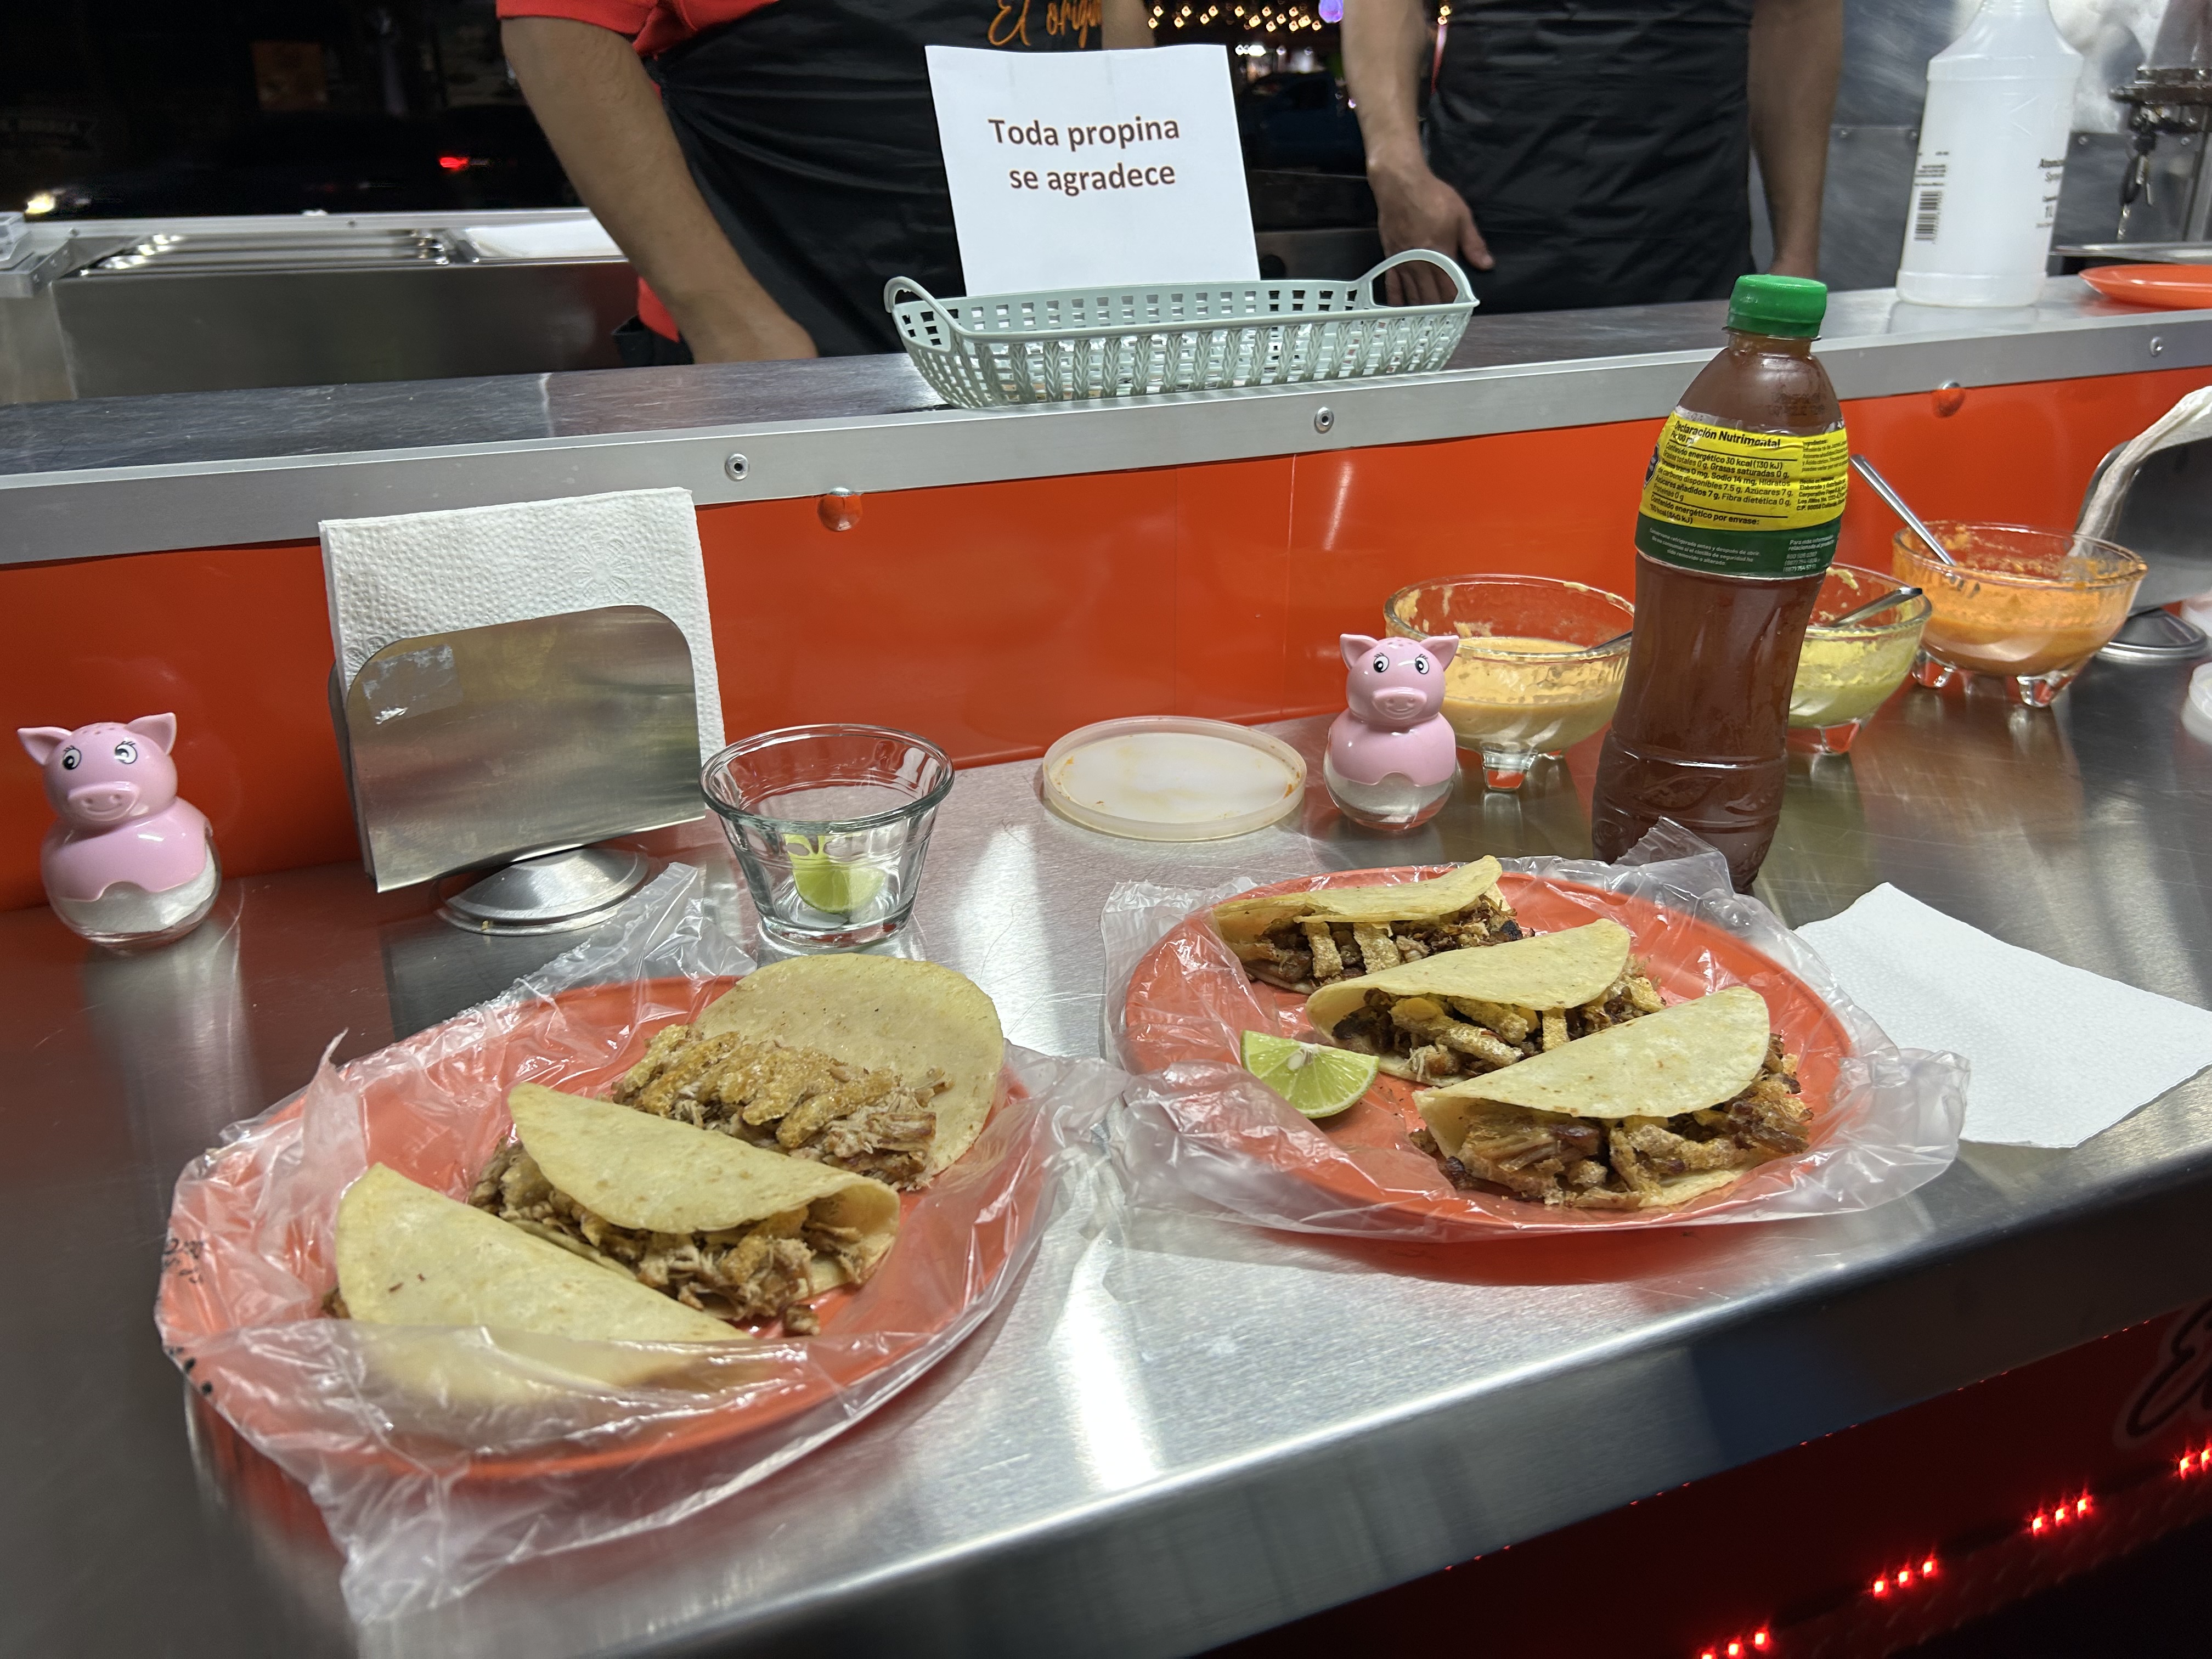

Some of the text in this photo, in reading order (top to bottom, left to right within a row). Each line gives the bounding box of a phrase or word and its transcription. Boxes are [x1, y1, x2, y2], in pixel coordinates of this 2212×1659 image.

[988, 116, 1181, 152] Toda propina
[1009, 162, 1176, 197] se agradece
[1675, 420, 1781, 447] Declaración Nutrimental
[1666, 442, 1782, 470] Contenido energético 30 kcal (130 kJ)
[1677, 456, 1696, 466] totales
[1711, 462, 1735, 473] Grasas
[1737, 468, 1775, 477] saturadas
[1663, 470, 1683, 481] carbono
[1684, 476, 1723, 490] disponibles
[1745, 487, 1780, 496] Azúcares
[1697, 471, 1709, 479] mg,
[1711, 472, 1731, 482] Sodio
[1759, 478, 1791, 487] Hidratos
[1677, 484, 1707, 496] añadidos
[1722, 494, 1741, 502] Fibra
[1743, 496, 1778, 505] dietética
[1651, 494, 1674, 510] Contenido
[1674, 505, 1712, 519] energético
[1729, 516, 1760, 525] envase:
